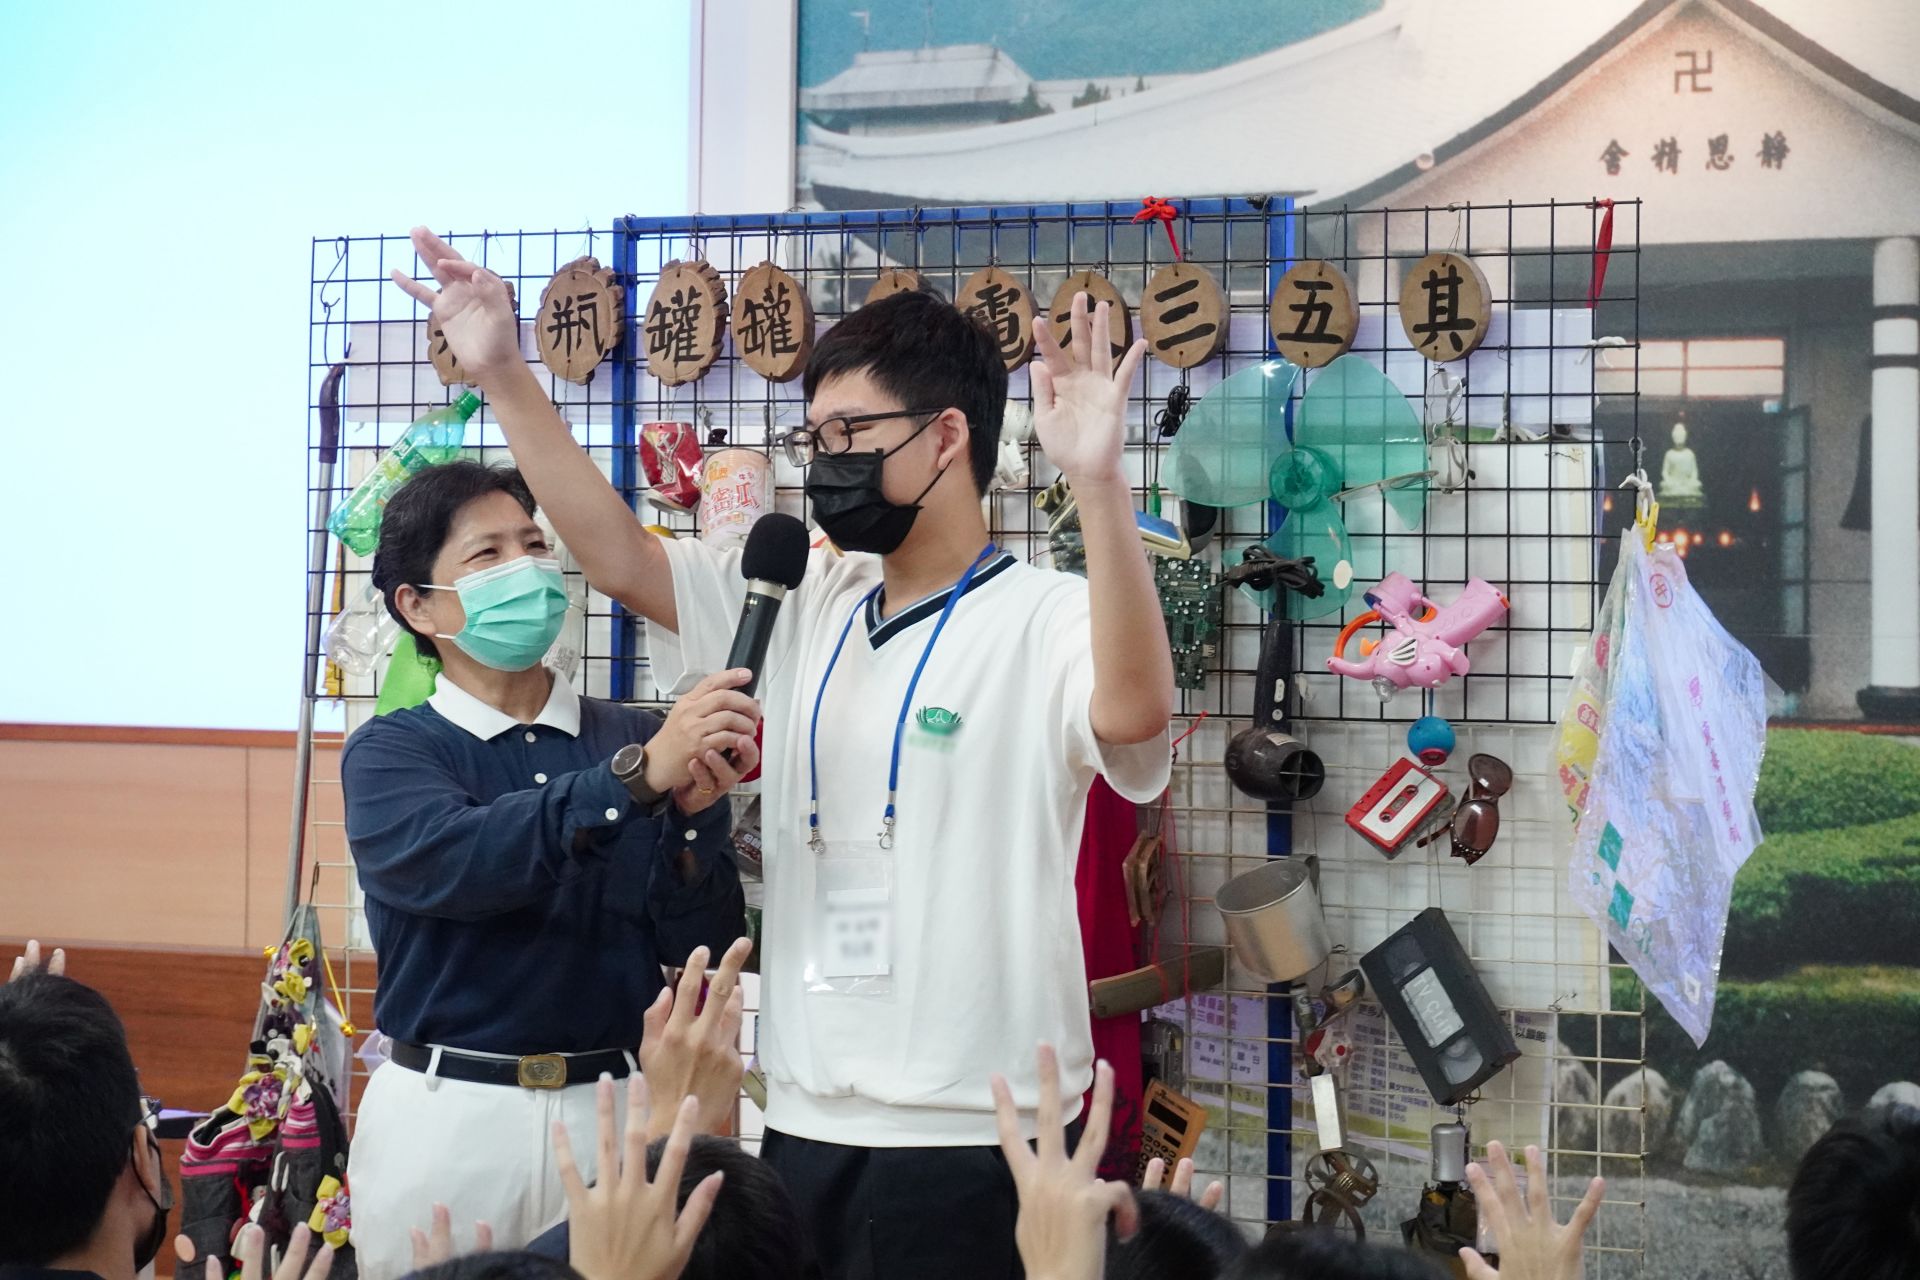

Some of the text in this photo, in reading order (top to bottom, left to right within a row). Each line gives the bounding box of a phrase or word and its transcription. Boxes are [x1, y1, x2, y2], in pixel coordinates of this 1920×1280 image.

[546, 292, 604, 358] 瓶
[645, 285, 706, 362] 罐
[737, 281, 800, 359] 罐
[1154, 280, 1217, 352] 三
[1277, 280, 1344, 345] 五
[1412, 266, 1477, 351] 其
